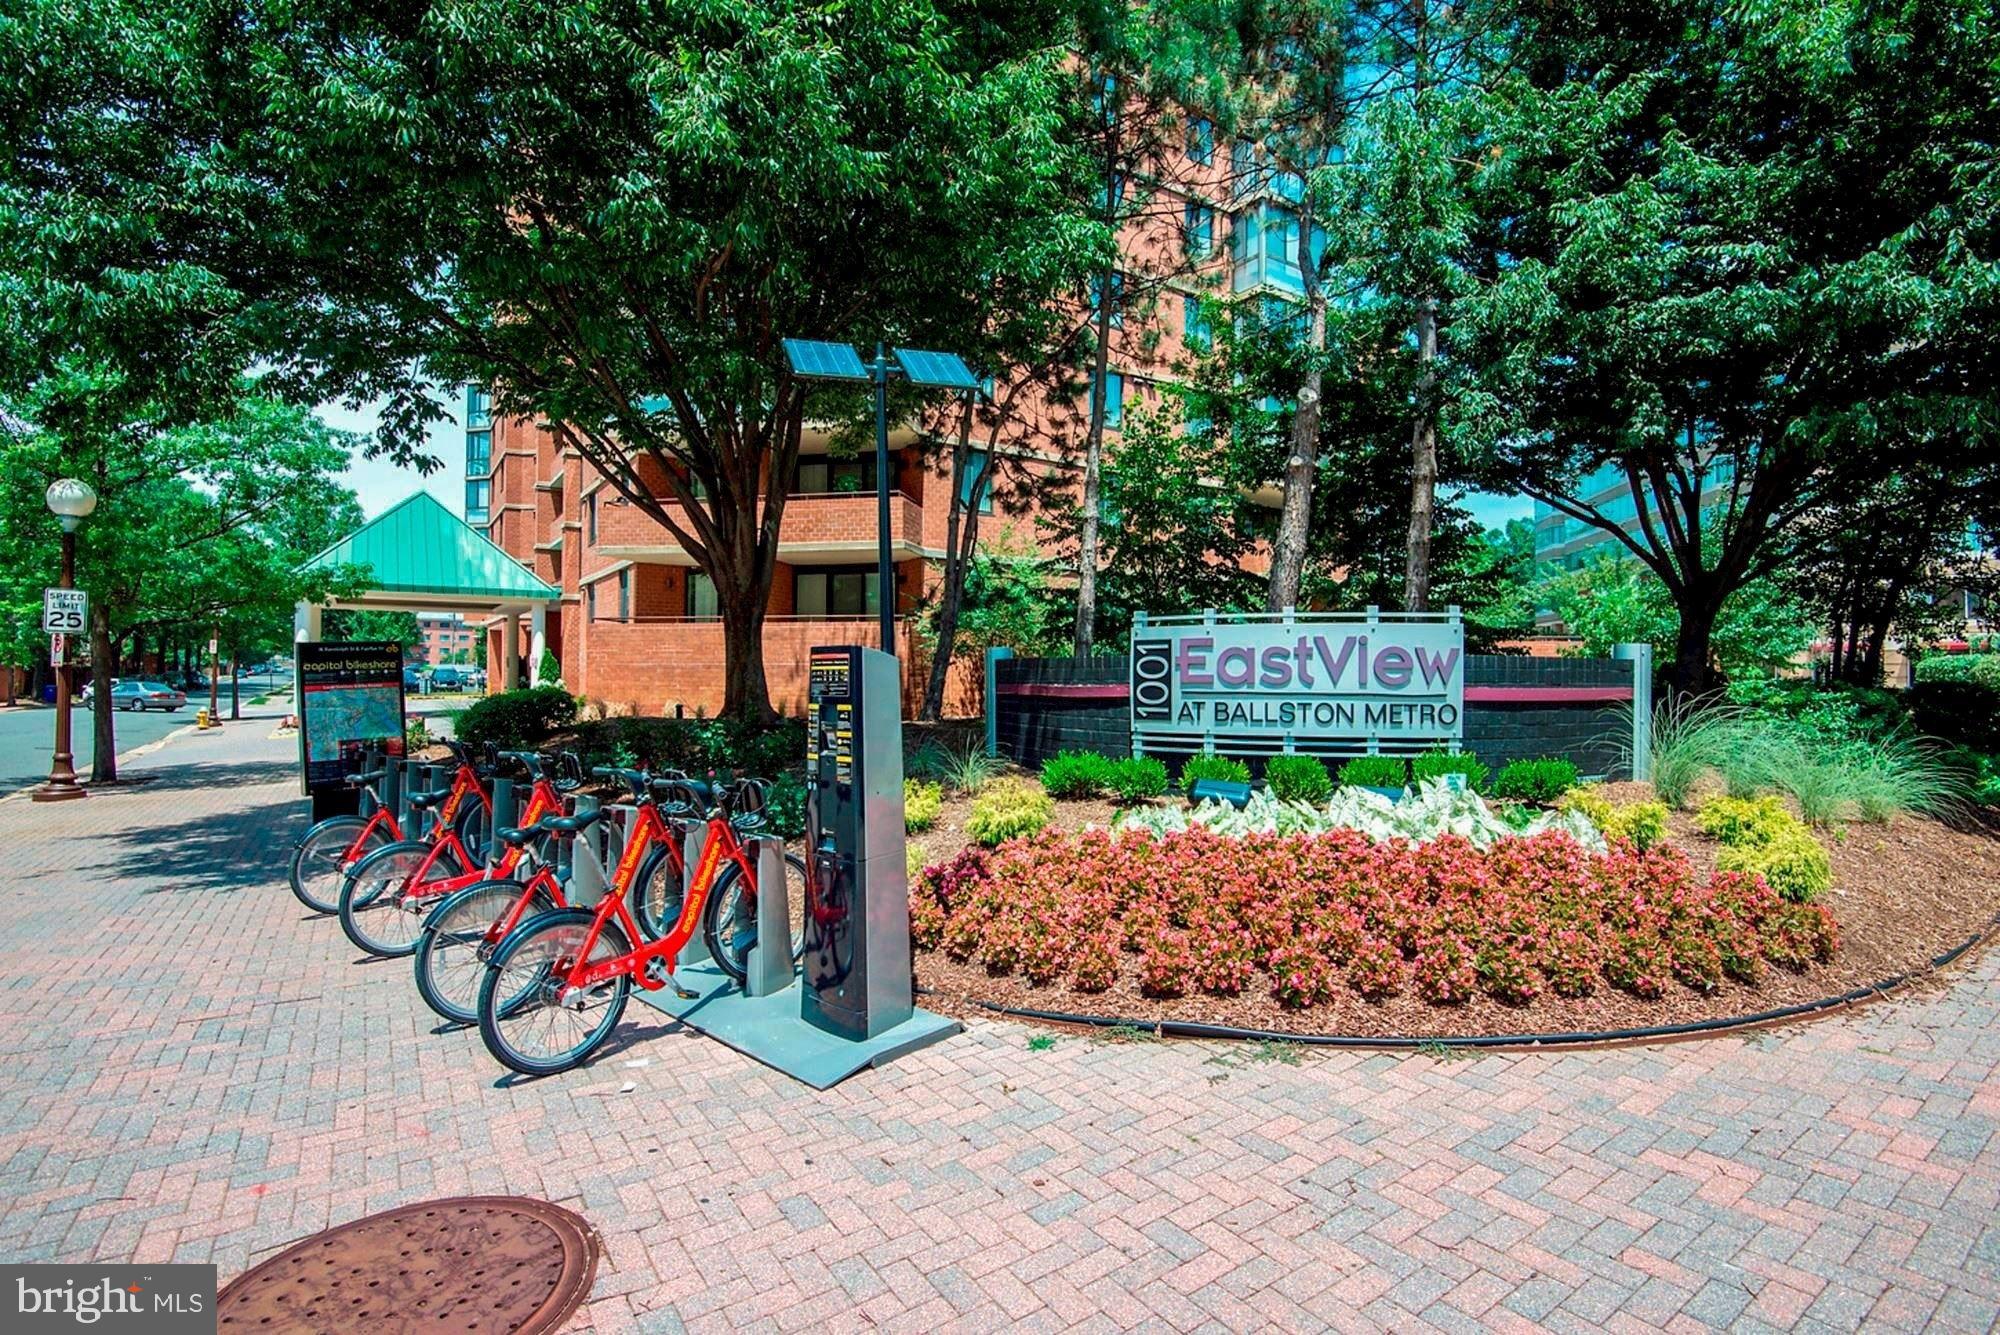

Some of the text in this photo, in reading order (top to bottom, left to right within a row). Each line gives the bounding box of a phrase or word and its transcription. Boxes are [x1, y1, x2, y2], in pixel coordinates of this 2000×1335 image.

[49, 592, 85, 601] SPEED
[52, 602, 80, 610] LIMIT
[48, 611, 82, 628] 25
[303, 659, 397, 672] capital bikeshare
[1175, 634, 1461, 689] EastView
[1135, 643, 1170, 719] 1001
[1177, 701, 1458, 727] AT BALLSTON METRO
[682, 841, 721, 933] capital bikeshare
